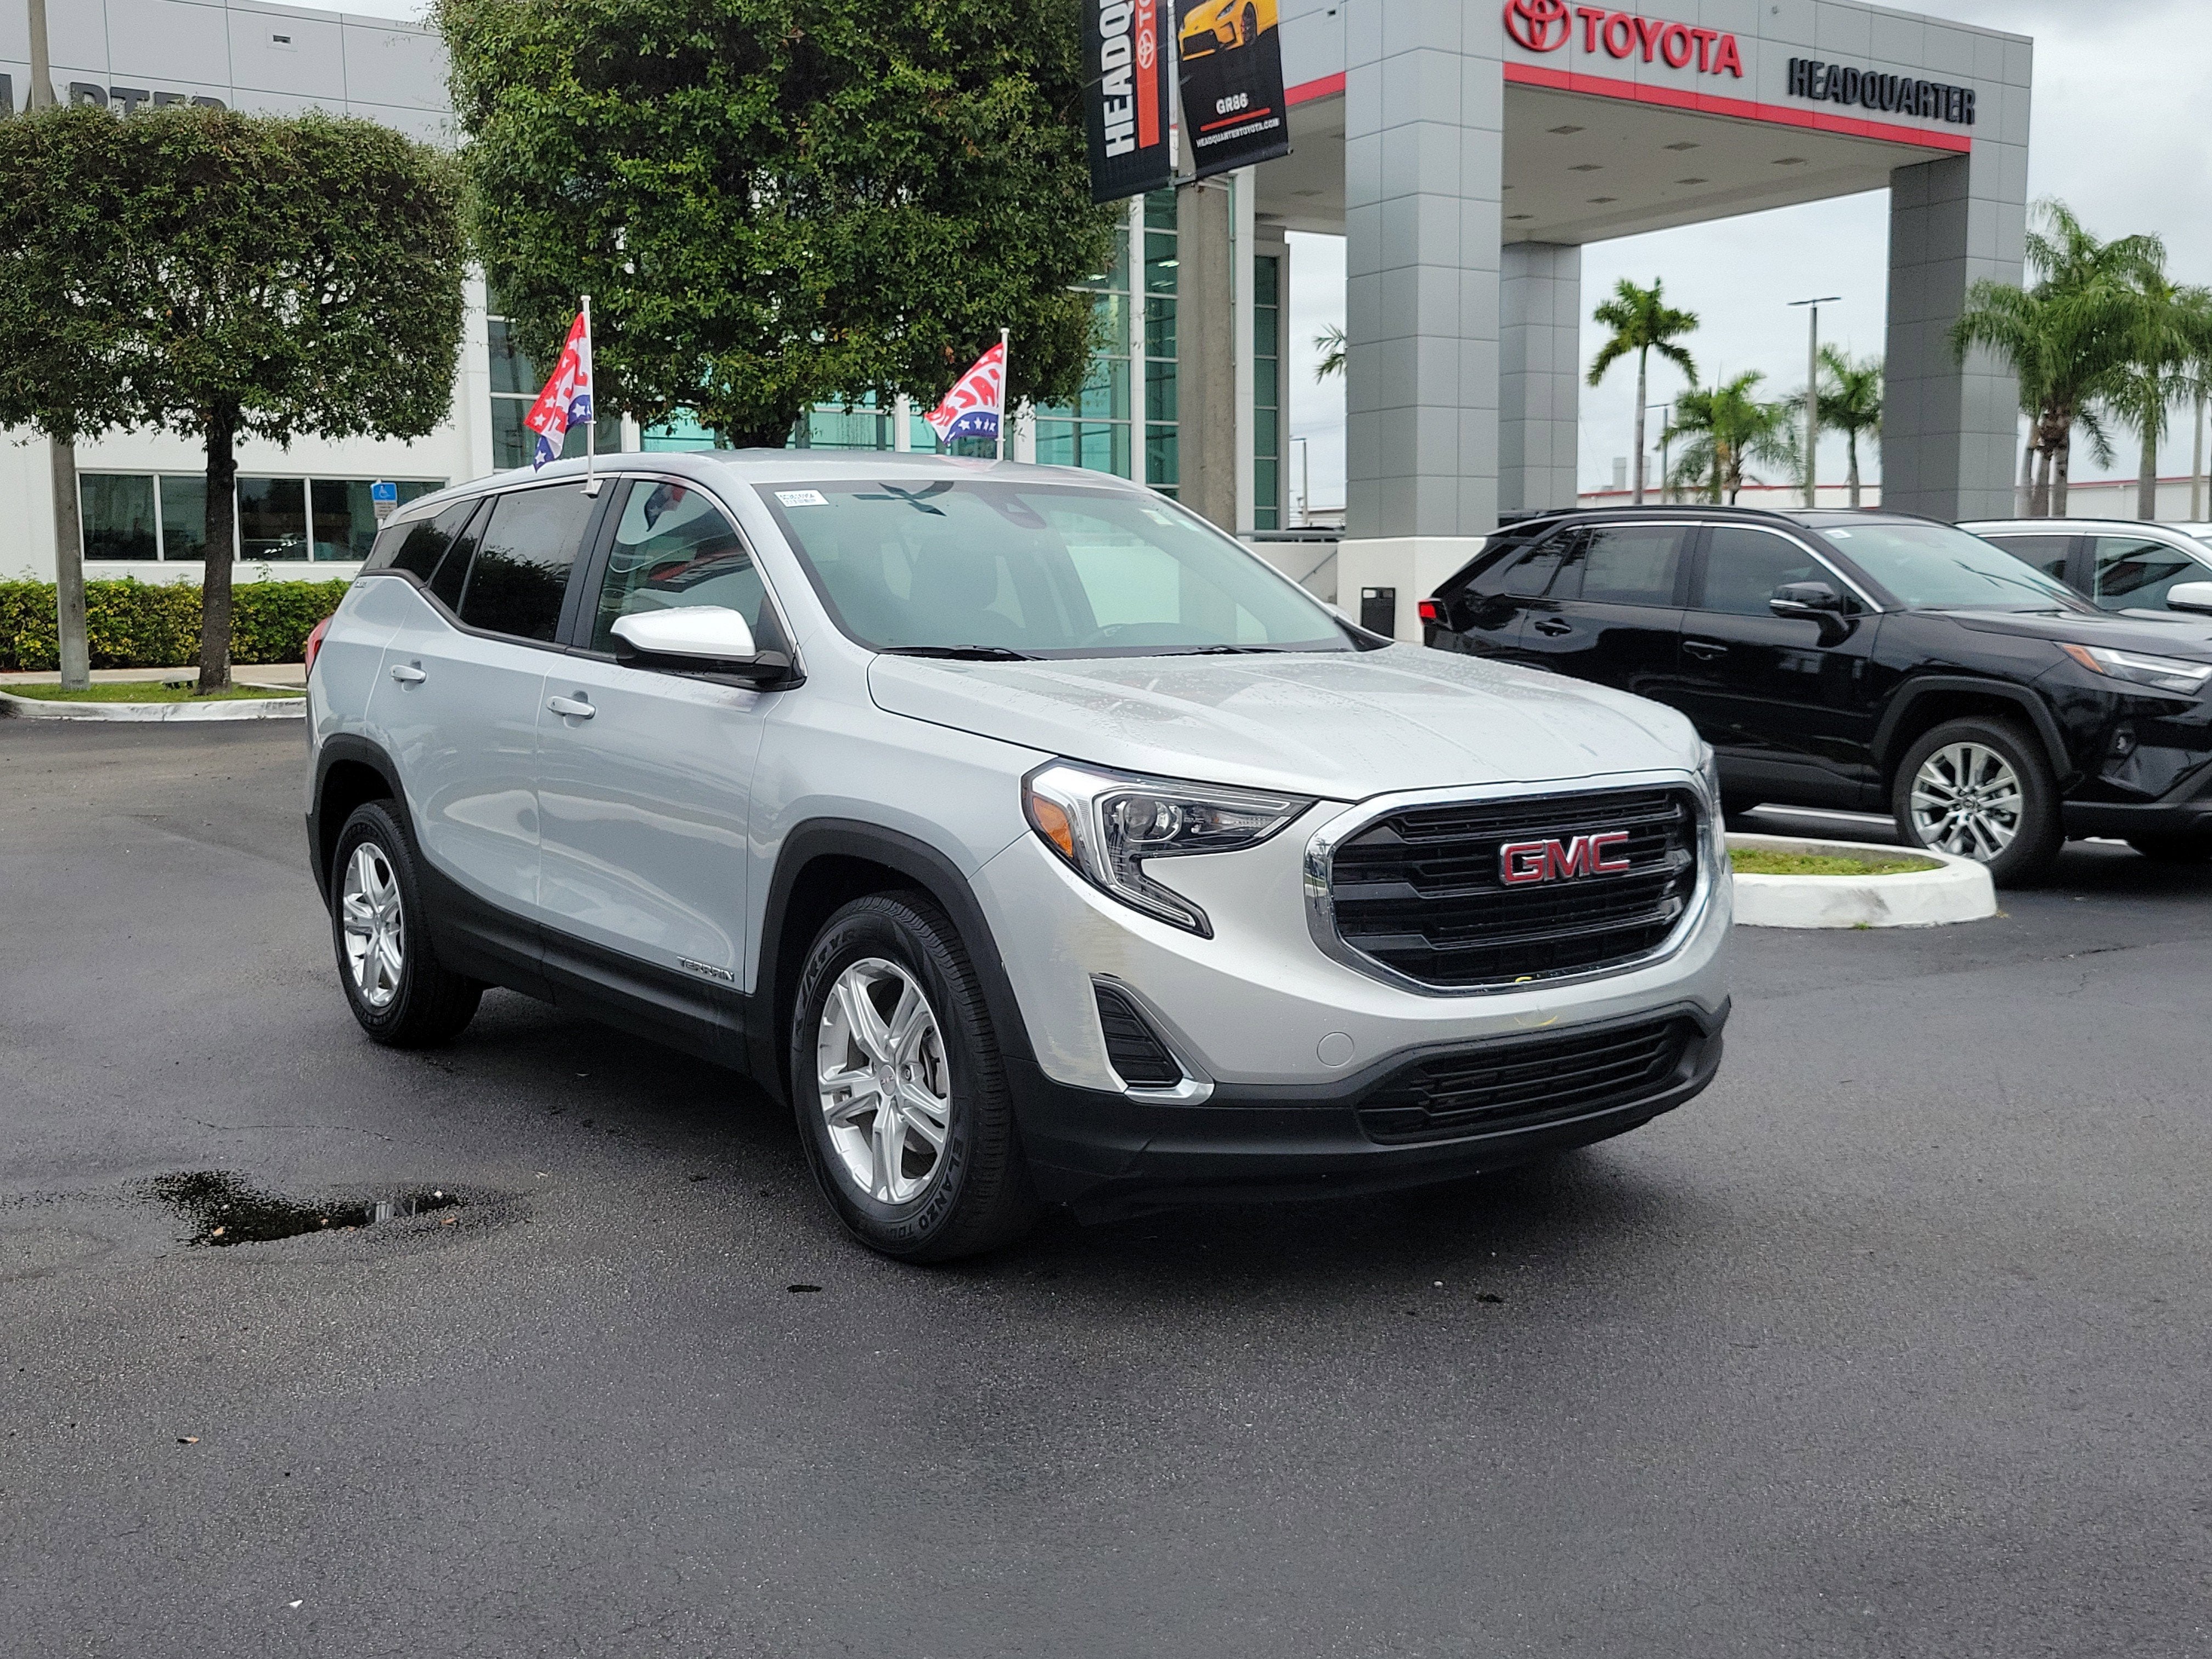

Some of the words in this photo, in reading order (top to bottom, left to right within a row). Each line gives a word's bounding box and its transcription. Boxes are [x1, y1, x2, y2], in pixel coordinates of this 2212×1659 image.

[1577, 7, 1743, 78] TOYOTA
[1216, 92, 1249, 115] GR86
[1787, 57, 1976, 126] HEADQUARTER
[1500, 830, 1631, 885] GMC
[676, 956, 735, 982] TERRAIN
[919, 1137, 963, 1230] ELANZO
